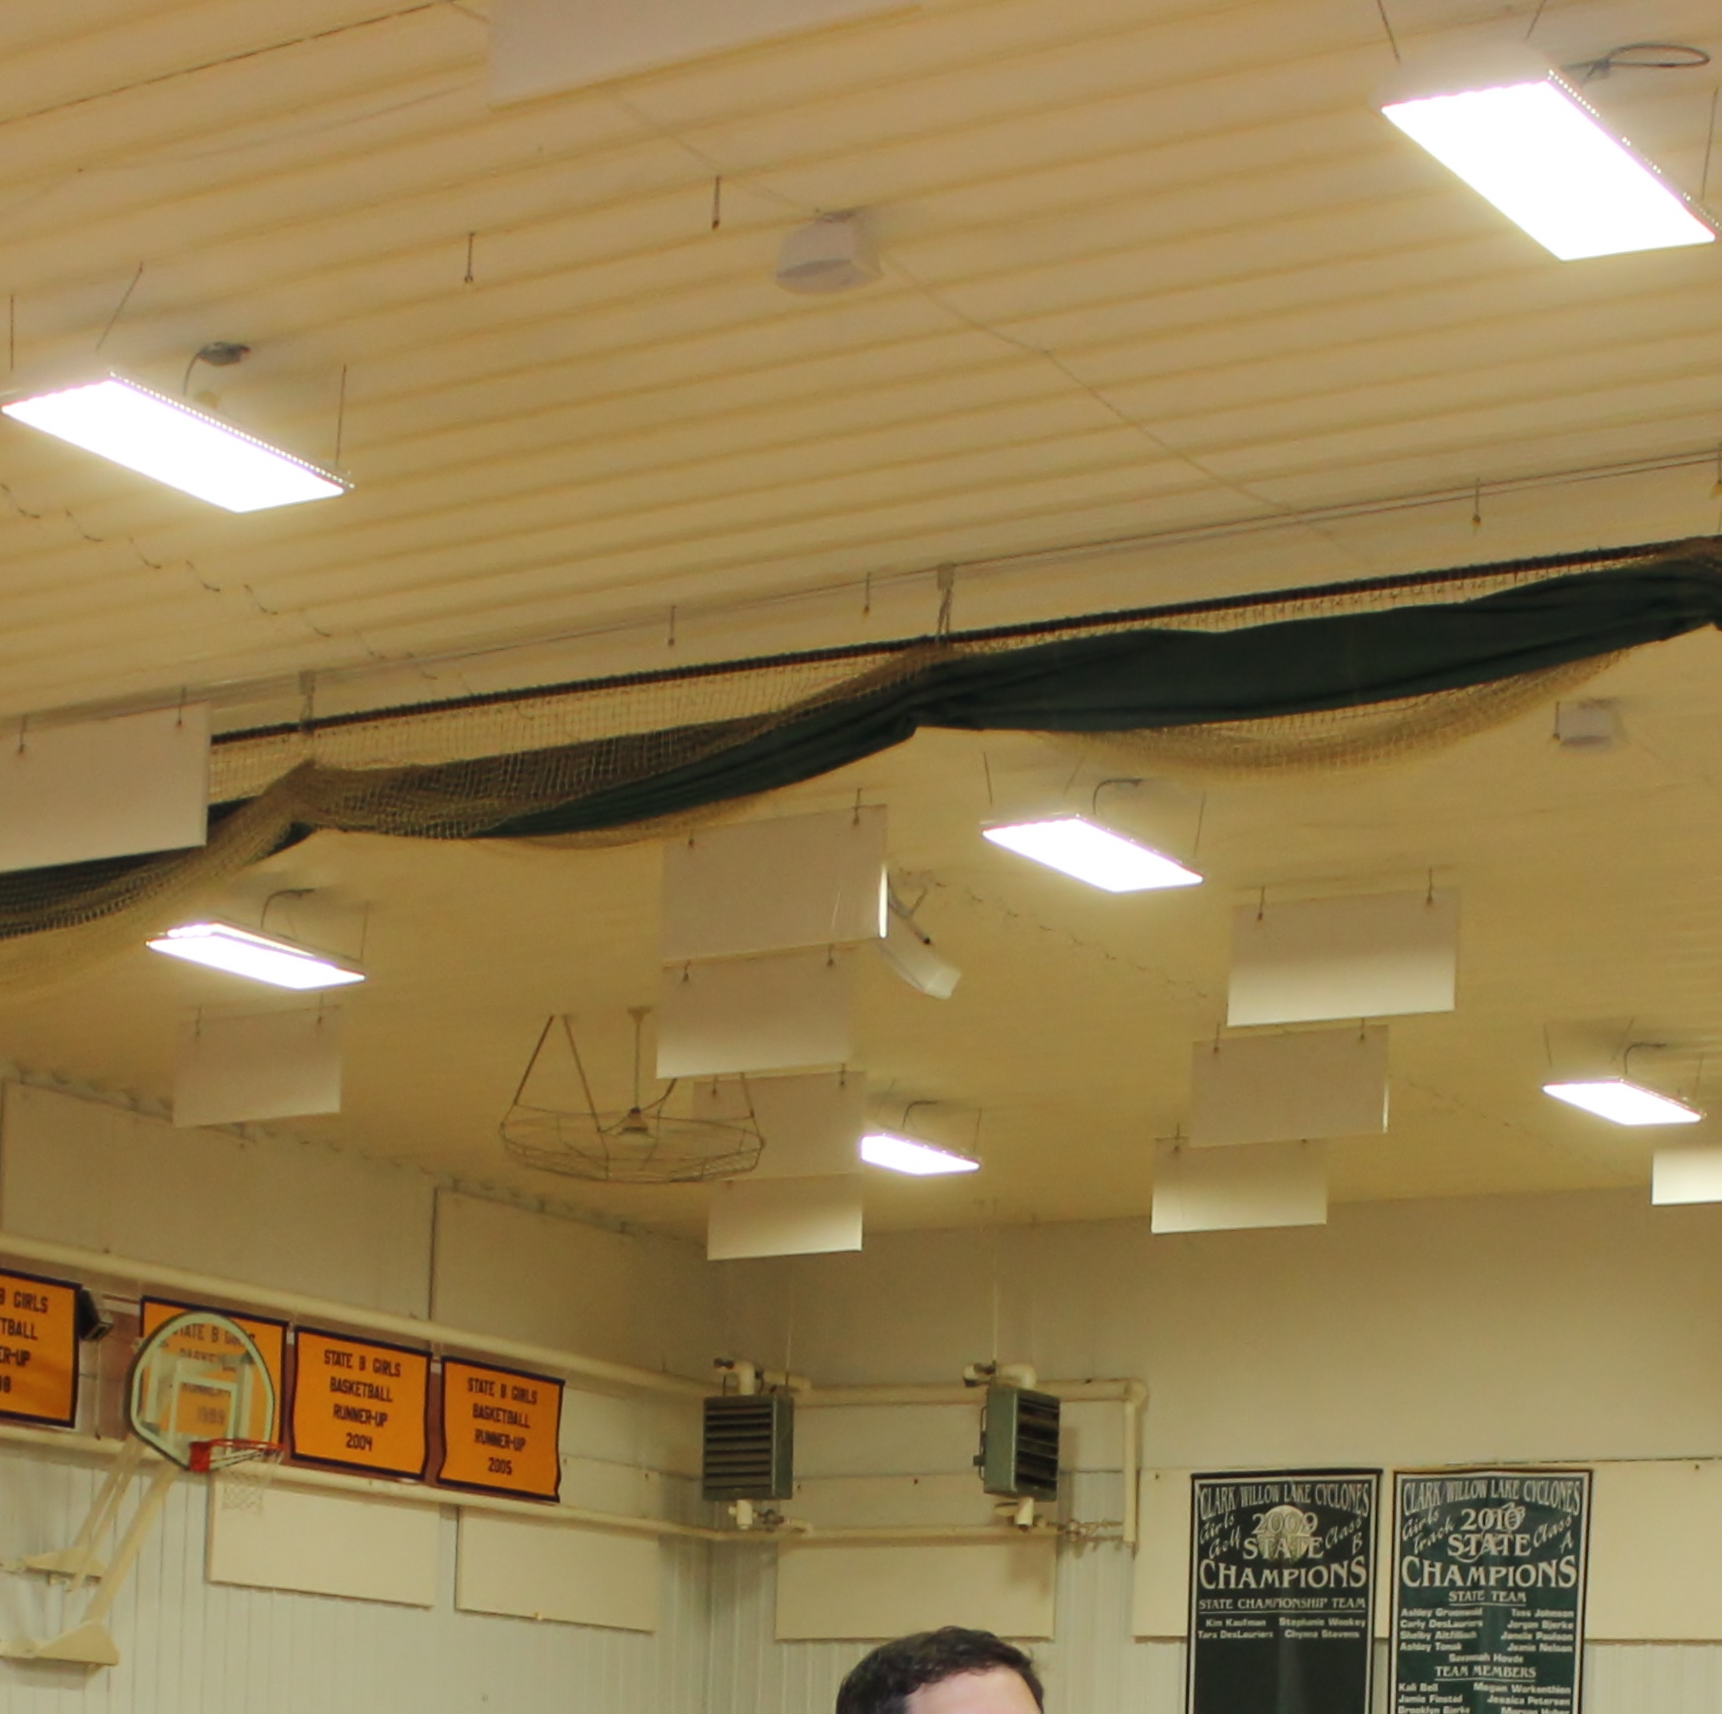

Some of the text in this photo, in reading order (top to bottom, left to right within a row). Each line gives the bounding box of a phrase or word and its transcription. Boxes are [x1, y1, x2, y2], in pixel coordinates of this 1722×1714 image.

[13, 1290, 49, 1314] GIRLS
[324, 1349, 401, 1378] STATE B GIRLS
[330, 1376, 393, 1402] BASKETBALL
[467, 1377, 538, 1406] STATE B GIRLS
[333, 1404, 388, 1428] RUNNER-UP
[472, 1402, 530, 1429] BASKETBALL
[346, 1433, 373, 1452] 2004
[475, 1428, 526, 1452] RUNNER-UP
[1200, 1483, 1370, 1521] CLARK WILLOW LAKE CYCLONES
[1403, 1479, 1580, 1516] CLARK WILLOW LAKE CYCLONES
[1252, 1512, 1318, 1535] 2009
[1460, 1507, 1522, 1531] 2010
[1243, 1536, 1325, 1560] STATE
[1447, 1533, 1531, 1557] STATE
[1200, 1555, 1367, 1590] CHAMPIONS
[1402, 1555, 1577, 1588] CHAMPIONS
[1199, 1597, 1366, 1610] STATE CHAMPIONSHIP TEAM
[1449, 1590, 1527, 1603] STATE TEAM
[1435, 1665, 1536, 1678] TEAM MEMBERS
